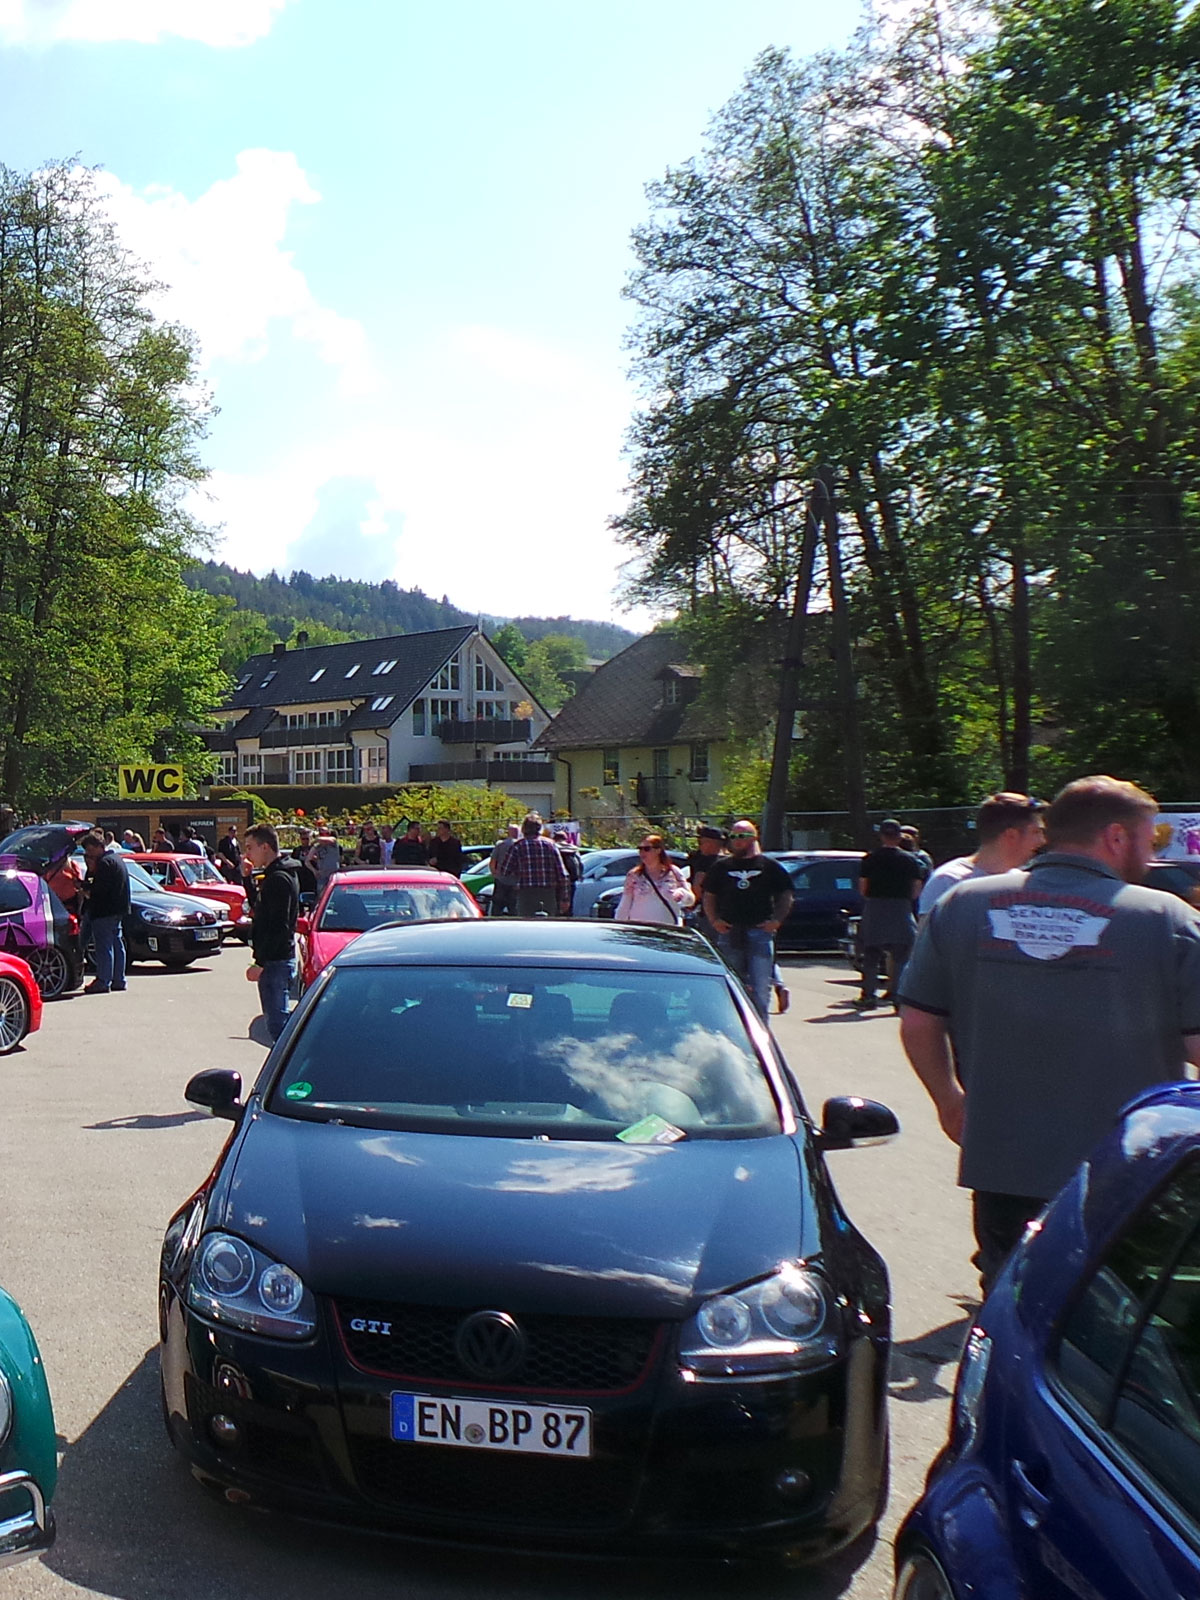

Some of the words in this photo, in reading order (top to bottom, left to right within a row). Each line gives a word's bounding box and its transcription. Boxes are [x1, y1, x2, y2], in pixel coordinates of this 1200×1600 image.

[123, 768, 180, 794] WC
[1008, 908, 1087, 925] GENUINE
[1014, 929, 1075, 943] BRAND
[350, 1318, 392, 1336] GTI
[399, 1421, 409, 1433] D
[418, 1401, 461, 1441] EN
[489, 1407, 532, 1445] BP
[542, 1412, 585, 1450] 87
